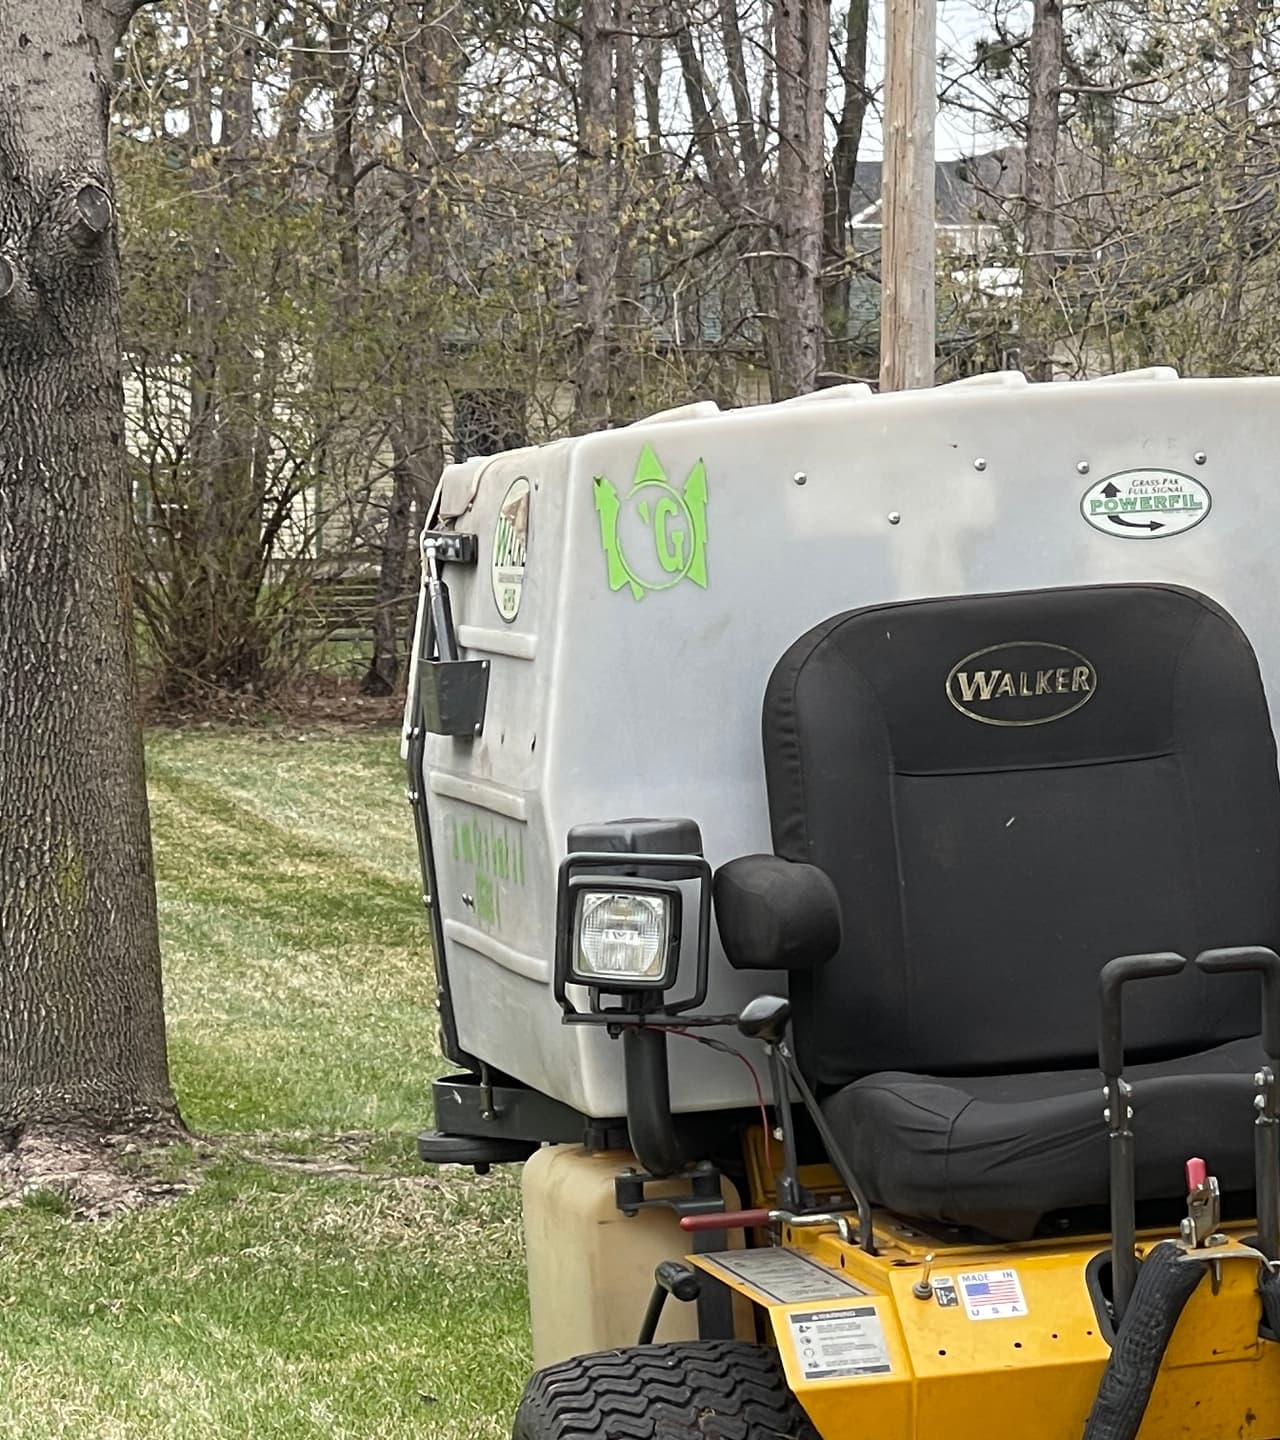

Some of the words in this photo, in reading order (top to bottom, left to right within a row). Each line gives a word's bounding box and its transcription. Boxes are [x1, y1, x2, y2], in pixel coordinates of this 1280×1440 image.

[1151, 485, 1184, 494] SIGNAL
[1089, 493, 1203, 513] POWERFIL
[956, 665, 1091, 702] WALKER
[961, 1273, 990, 1283] MADE
[1002, 1271, 1014, 1279] IN
